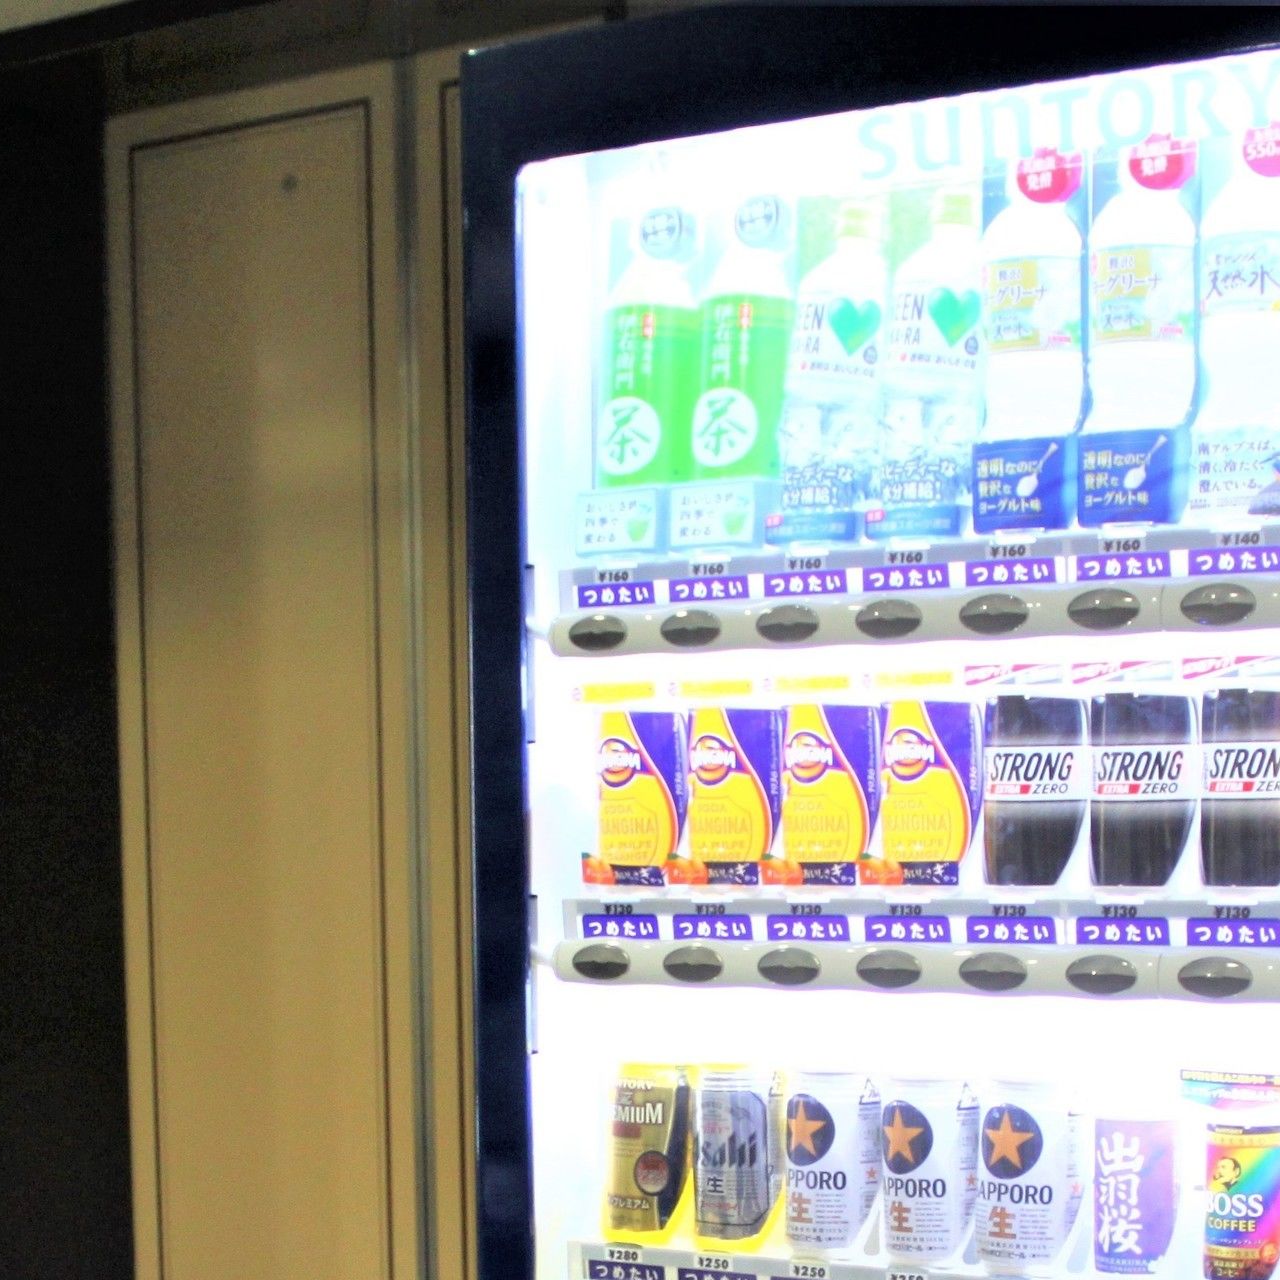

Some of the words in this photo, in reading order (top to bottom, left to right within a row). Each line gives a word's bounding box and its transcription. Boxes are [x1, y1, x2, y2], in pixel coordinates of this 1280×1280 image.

[607, 403, 651, 465] 茶
[698, 395, 748, 457] 茶
[1103, 538, 1140, 553] ¥160
[1221, 532, 1260, 545] ¥140
[889, 551, 923, 564] ¥160
[990, 544, 1026, 558] ¥160
[789, 558, 821, 570] ¥160
[1084, 554, 1163, 578] つめたい
[1196, 551, 1278, 571] つめたい
[599, 571, 629, 582] ¥160
[693, 564, 724, 575] ¥160
[869, 565, 943, 586] つめたい
[972, 560, 1048, 582] つめたい
[675, 580, 743, 599] つめたい
[771, 575, 841, 593] つめたい
[584, 586, 649, 605] つめたい
[990, 751, 1074, 782] STRONG
[1097, 749, 1184, 782] STRONG
[1032, 782, 1069, 795] ZERO
[1141, 781, 1179, 794] ZERO
[604, 904, 633, 915] ¥130
[696, 904, 725, 915] ¥130
[791, 904, 822, 915] ¥130
[889, 904, 922, 915] ¥130
[992, 905, 1026, 917] ¥130
[1101, 905, 1137, 918] ¥130
[1214, 906, 1251, 919] ¥130
[589, 921, 653, 937] つめたい
[679, 920, 747, 937] つめたい
[773, 921, 844, 939] つめたい
[871, 922, 944, 940] つめたい
[973, 922, 1050, 941] つめたい
[1083, 923, 1162, 943] つめたい
[1195, 925, 1277, 943] つめたい
[977, 1182, 1054, 1205] APPORO
[789, 1190, 814, 1225] 生
[889, 1200, 913, 1234] 生
[987, 1205, 1017, 1240] 生
[1207, 1217, 1256, 1232] COFFEE
[608, 1249, 639, 1262] ¥280
[697, 1256, 729, 1270] ¥250
[792, 1265, 826, 1278] ¥250
